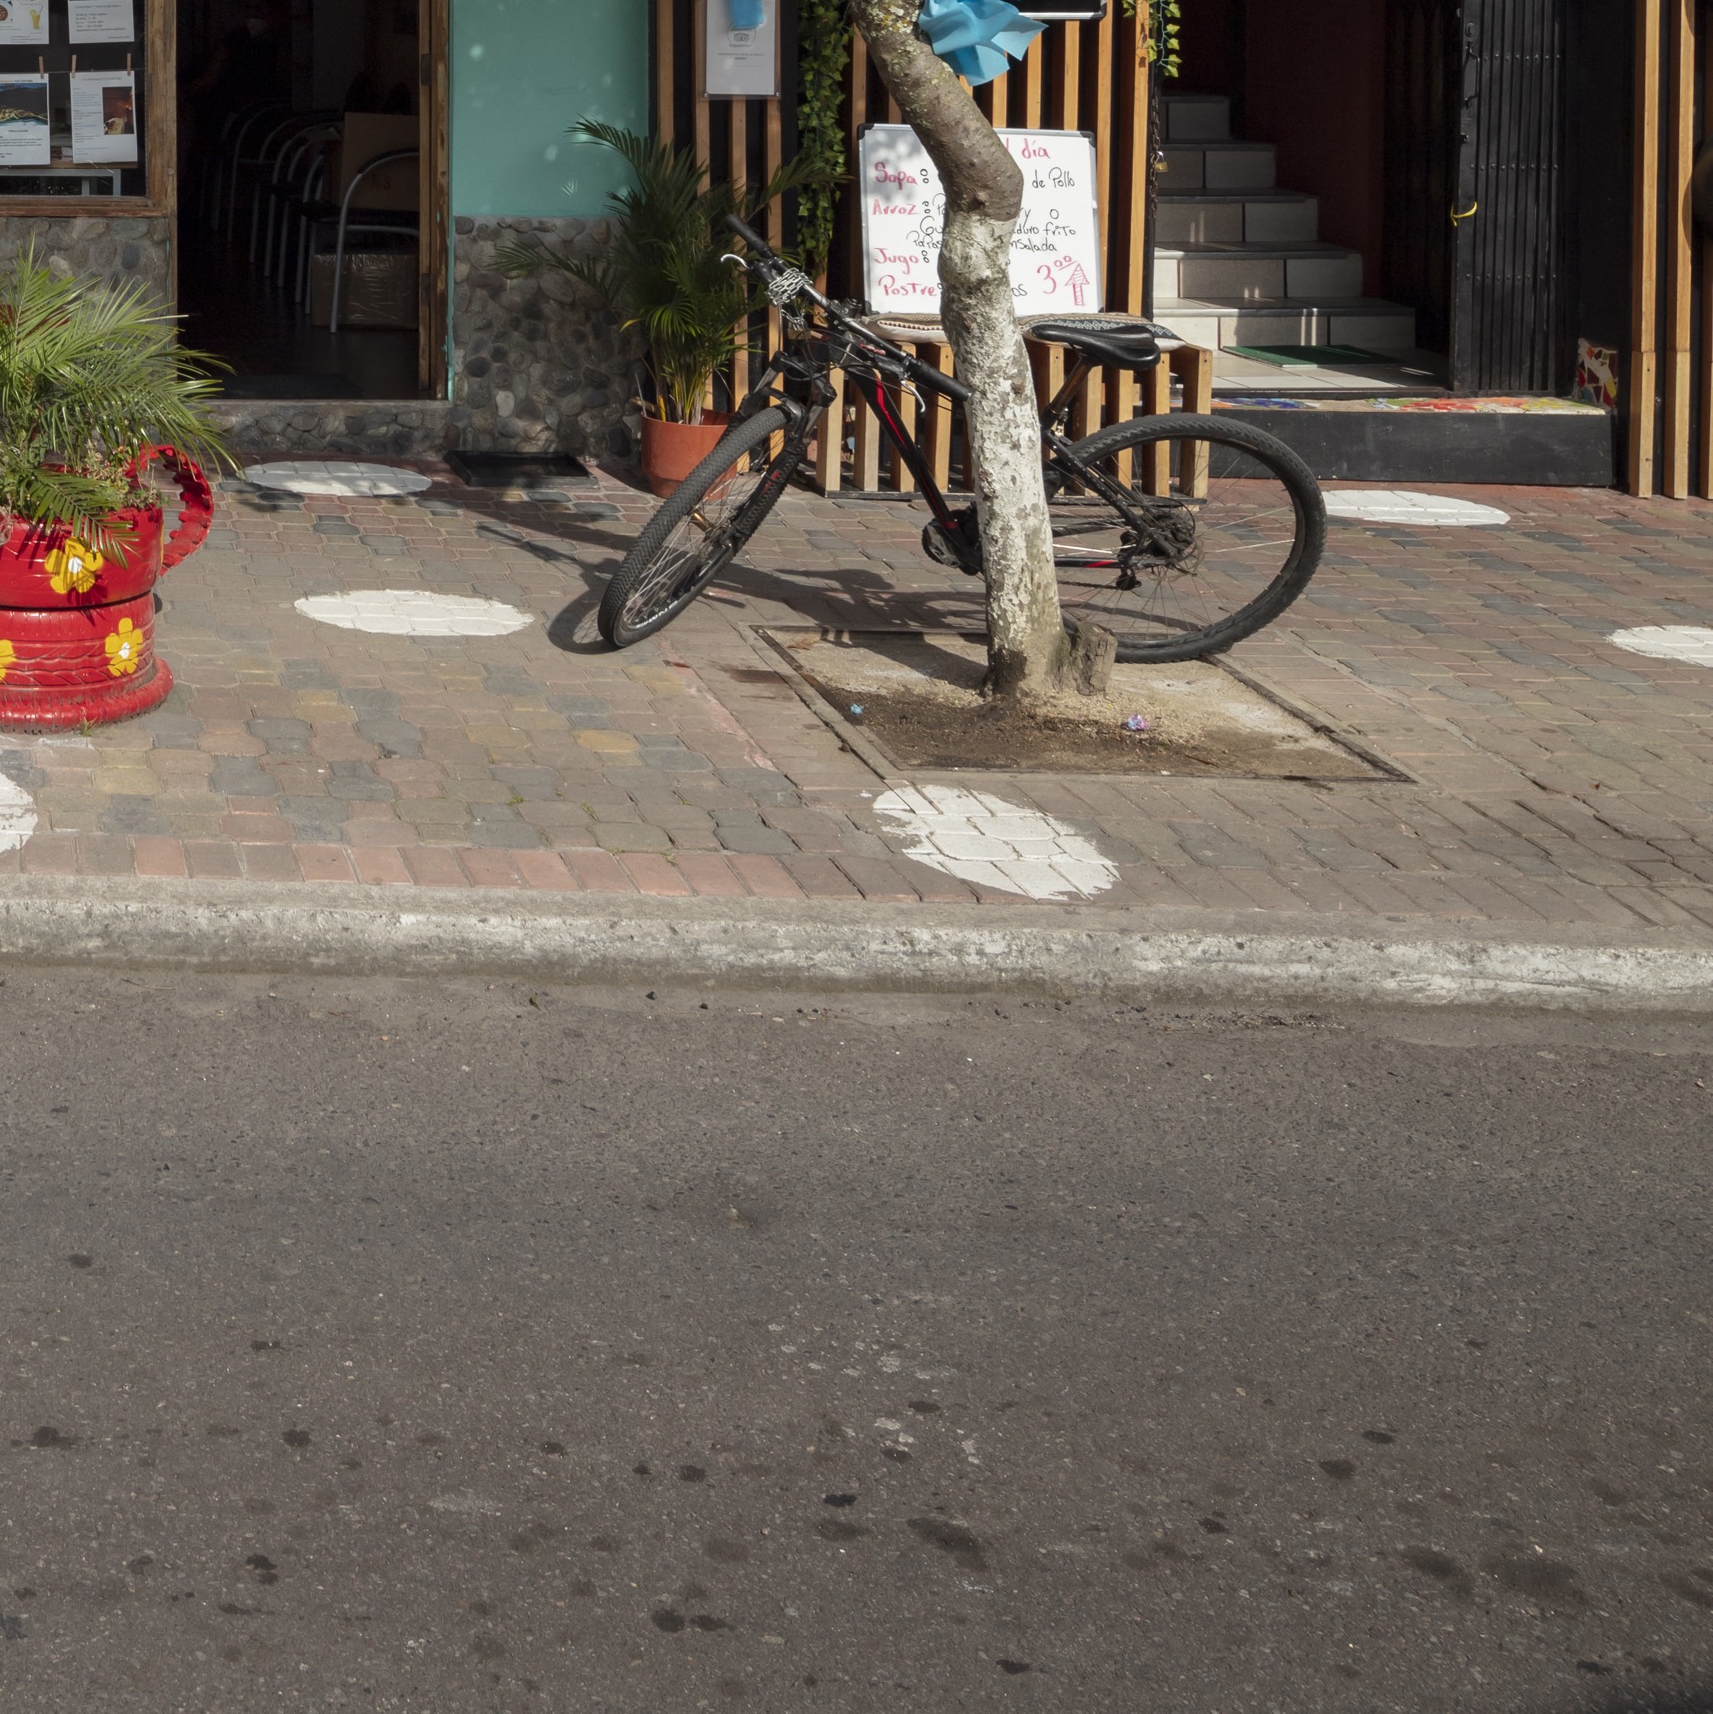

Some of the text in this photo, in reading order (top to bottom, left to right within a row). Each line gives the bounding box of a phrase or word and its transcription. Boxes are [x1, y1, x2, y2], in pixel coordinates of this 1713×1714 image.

[1031, 169, 1046, 189] de
[1048, 166, 1075, 188] Pollo
[1013, 224, 1040, 236] duro
